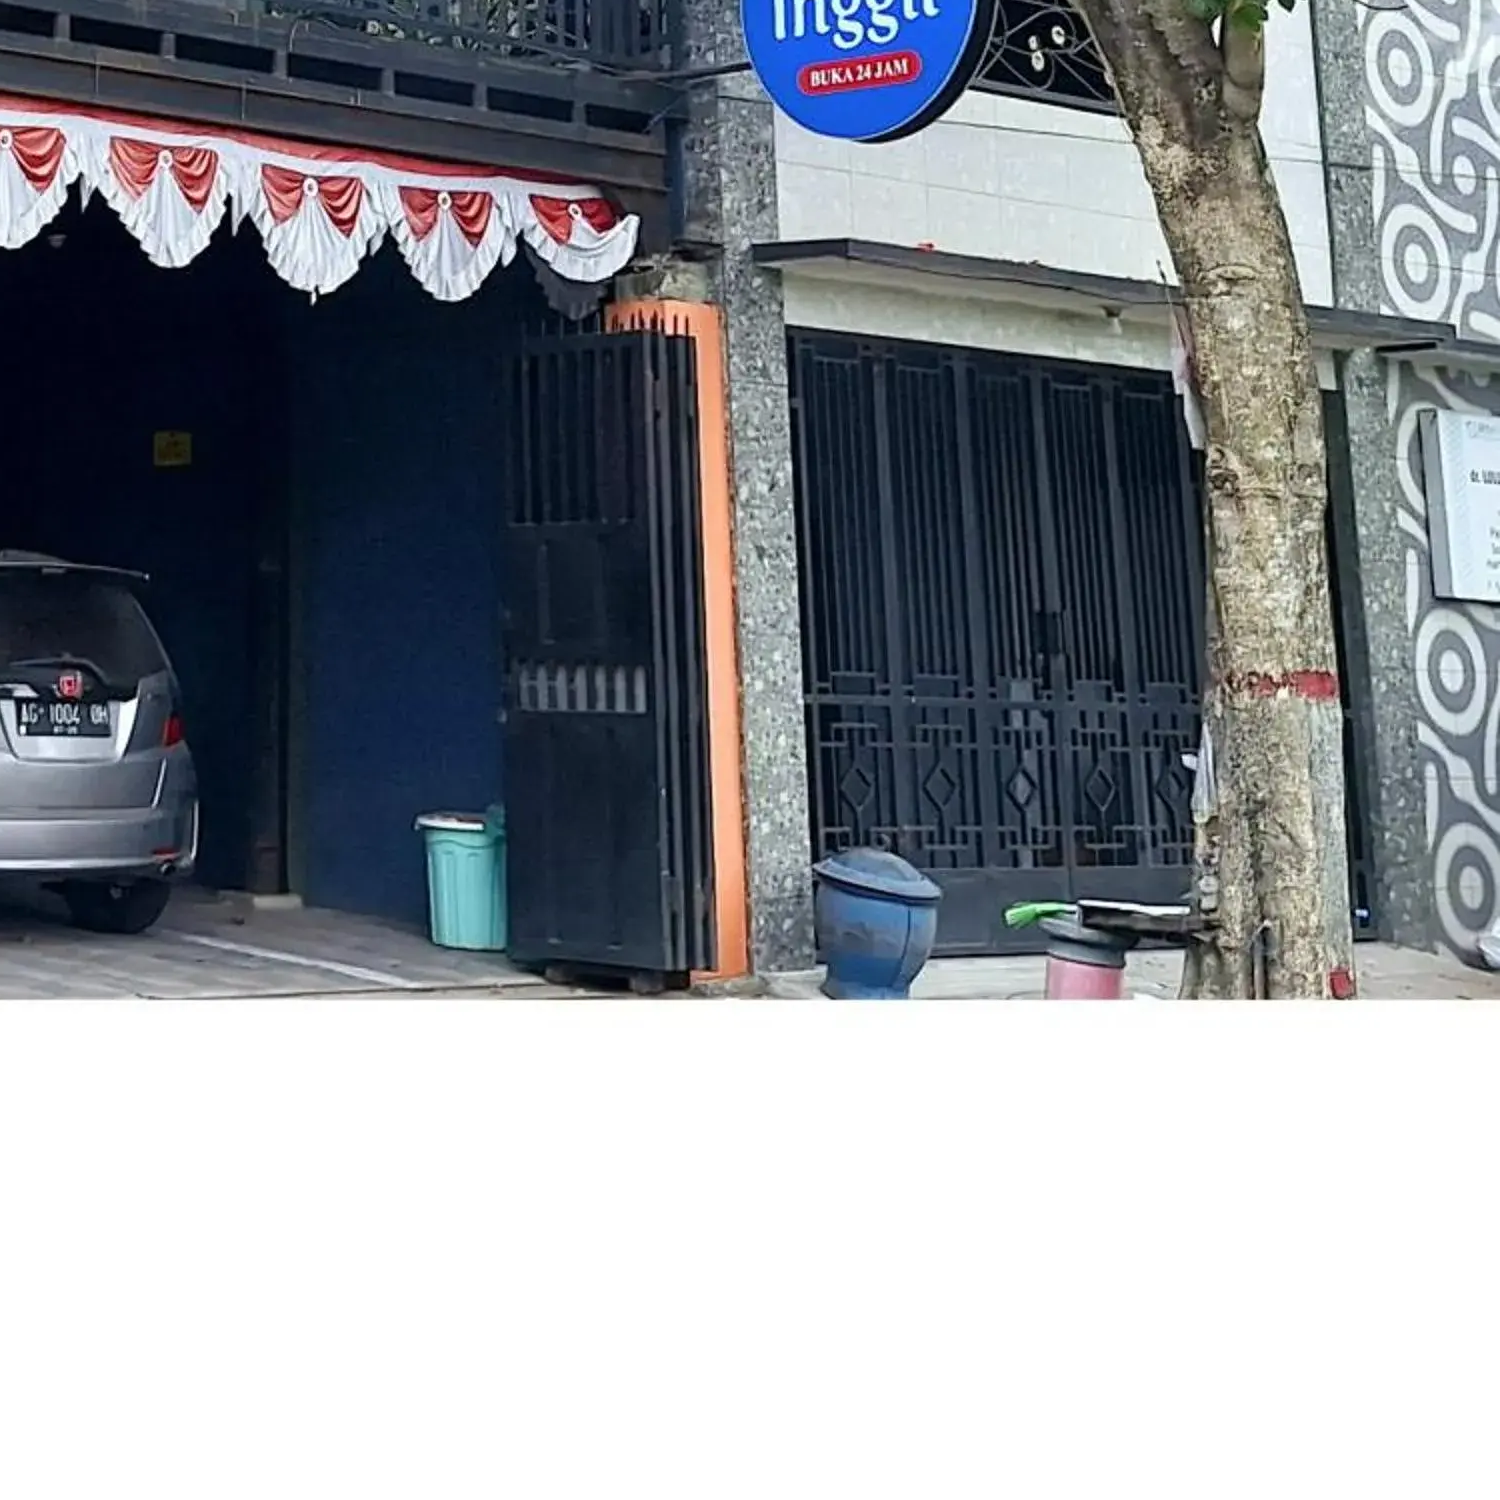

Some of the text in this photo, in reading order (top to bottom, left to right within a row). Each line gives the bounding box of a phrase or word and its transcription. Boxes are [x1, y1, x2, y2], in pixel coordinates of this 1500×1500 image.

[810, 58, 909, 87] BUKA 24 JAM
[21, 703, 39, 725] AG
[48, 703, 80, 726] 1004
